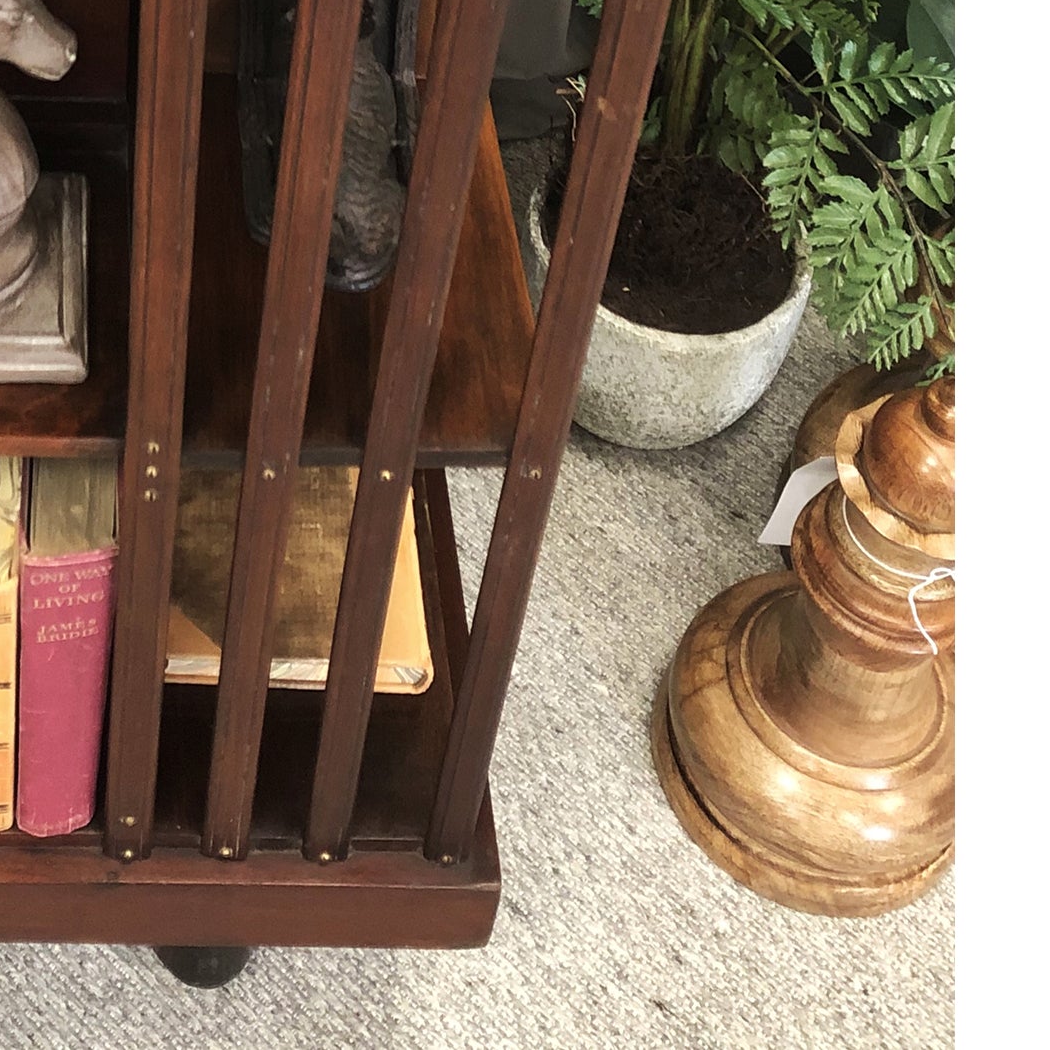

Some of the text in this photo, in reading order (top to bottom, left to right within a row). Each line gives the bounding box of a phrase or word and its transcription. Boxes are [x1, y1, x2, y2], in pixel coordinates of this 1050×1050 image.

[30, 563, 113, 586] ONE WAY
[58, 583, 81, 594] OF
[33, 590, 105, 610] LIVING
[36, 626, 99, 644] BRIDIE
[38, 617, 96, 635] JAMES
